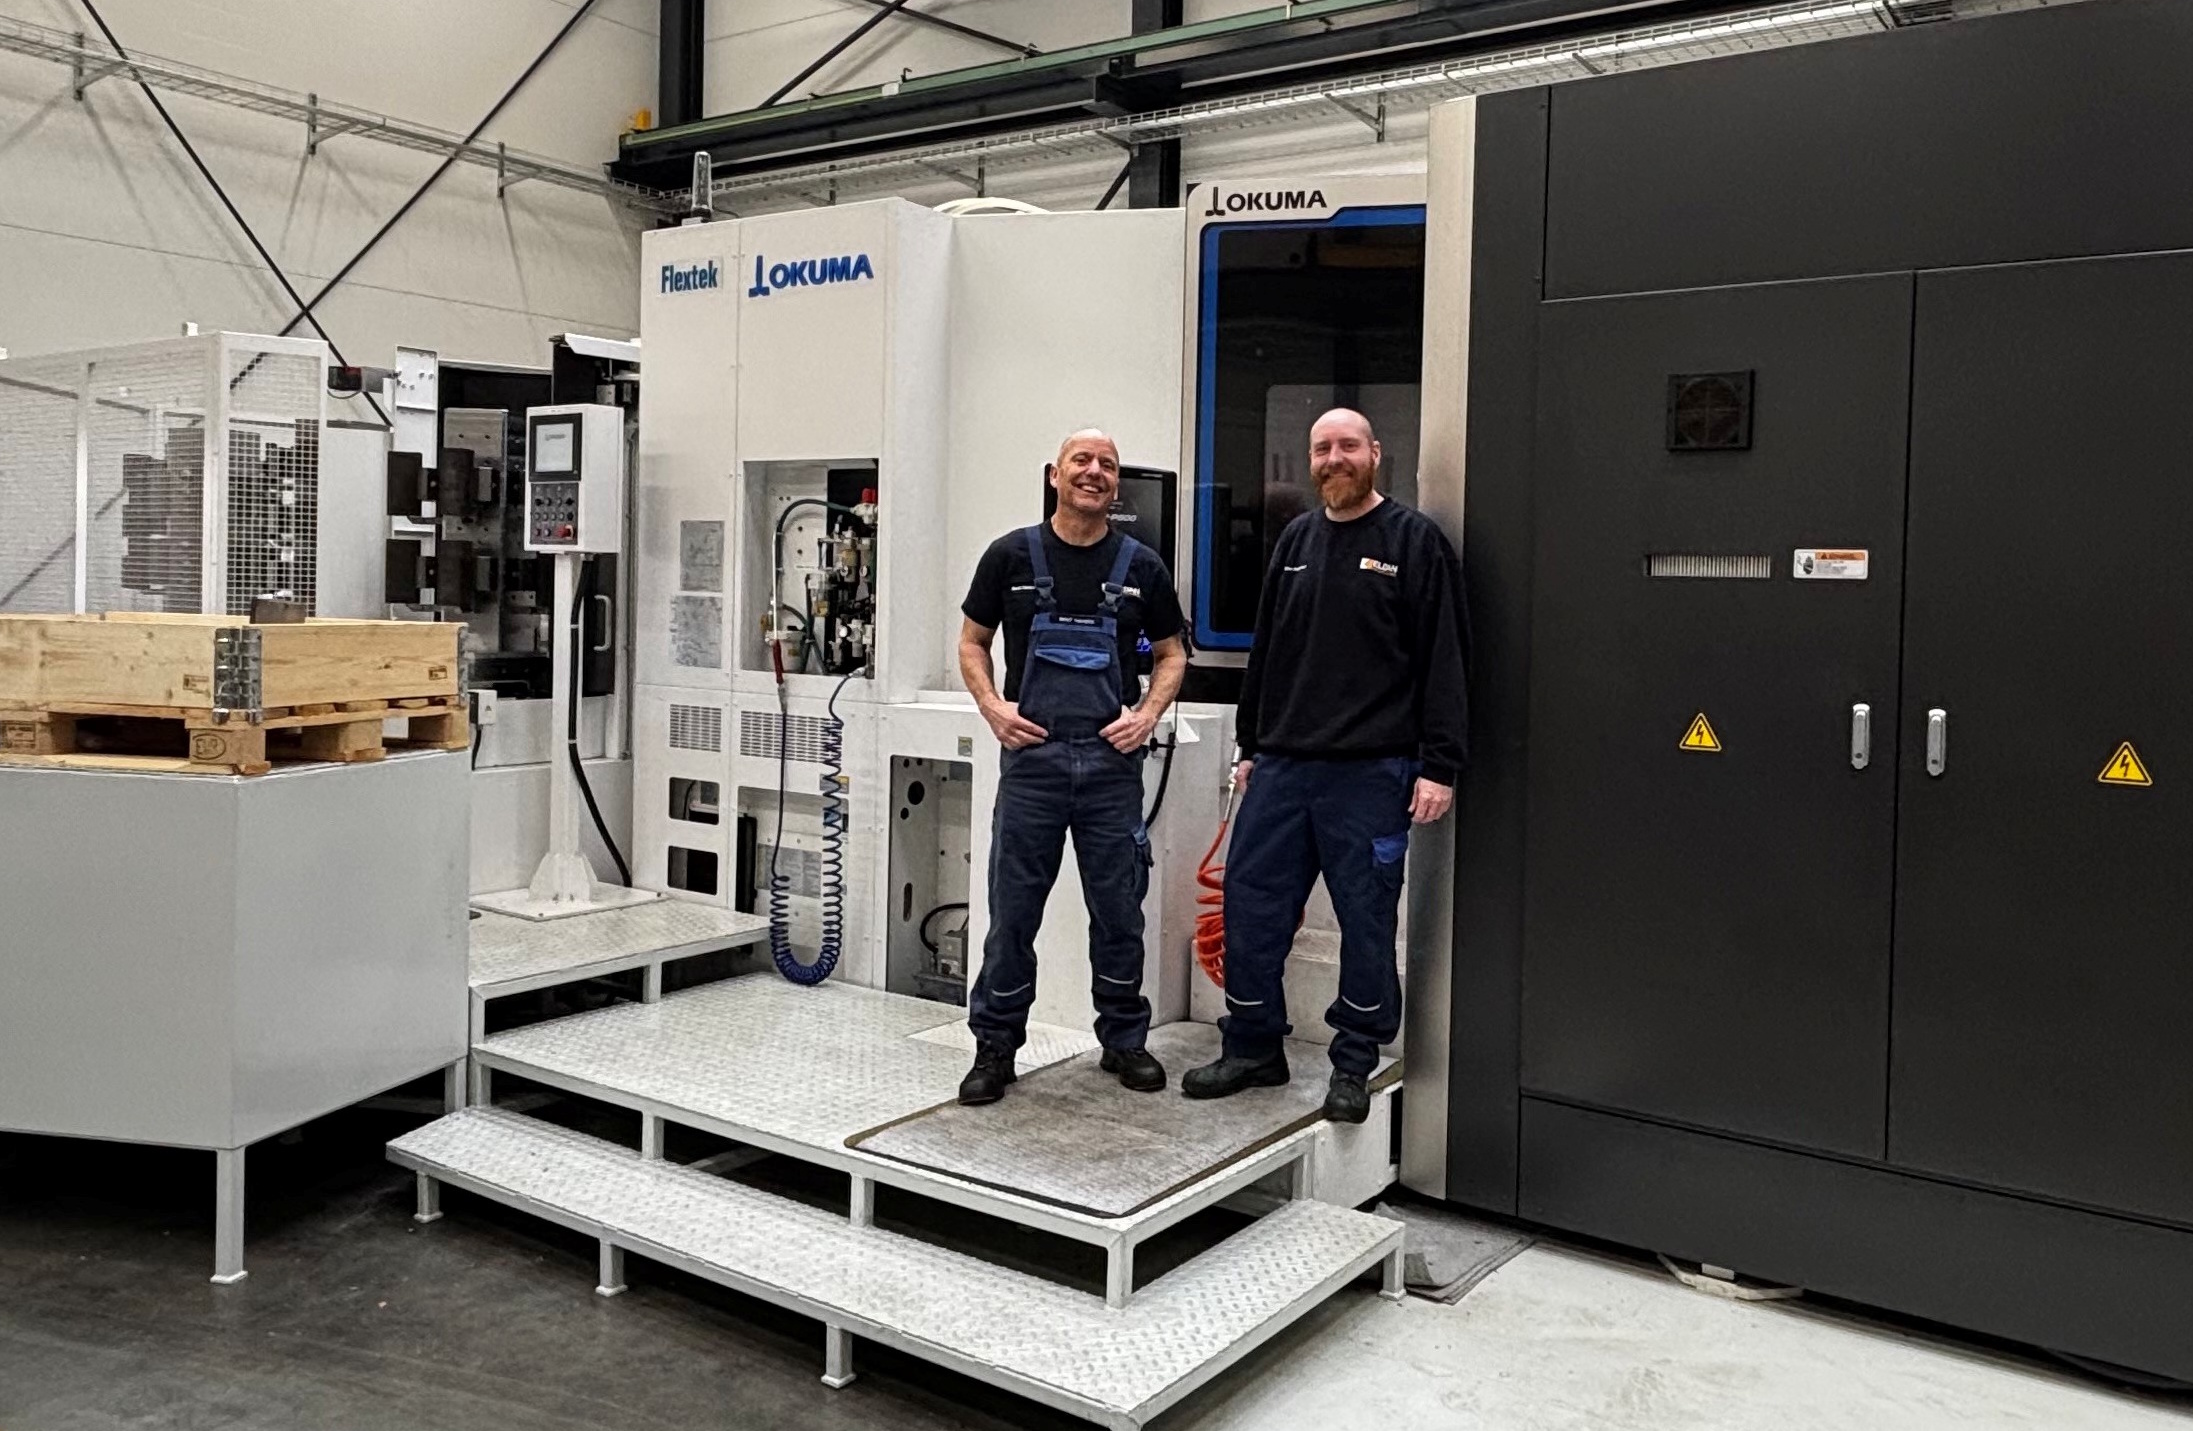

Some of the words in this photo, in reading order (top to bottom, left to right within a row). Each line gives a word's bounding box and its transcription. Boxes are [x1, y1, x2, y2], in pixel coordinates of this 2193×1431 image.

[1226, 189, 1328, 213] OKUMA
[661, 260, 718, 294] Flextek
[768, 254, 875, 290] OKUMA
